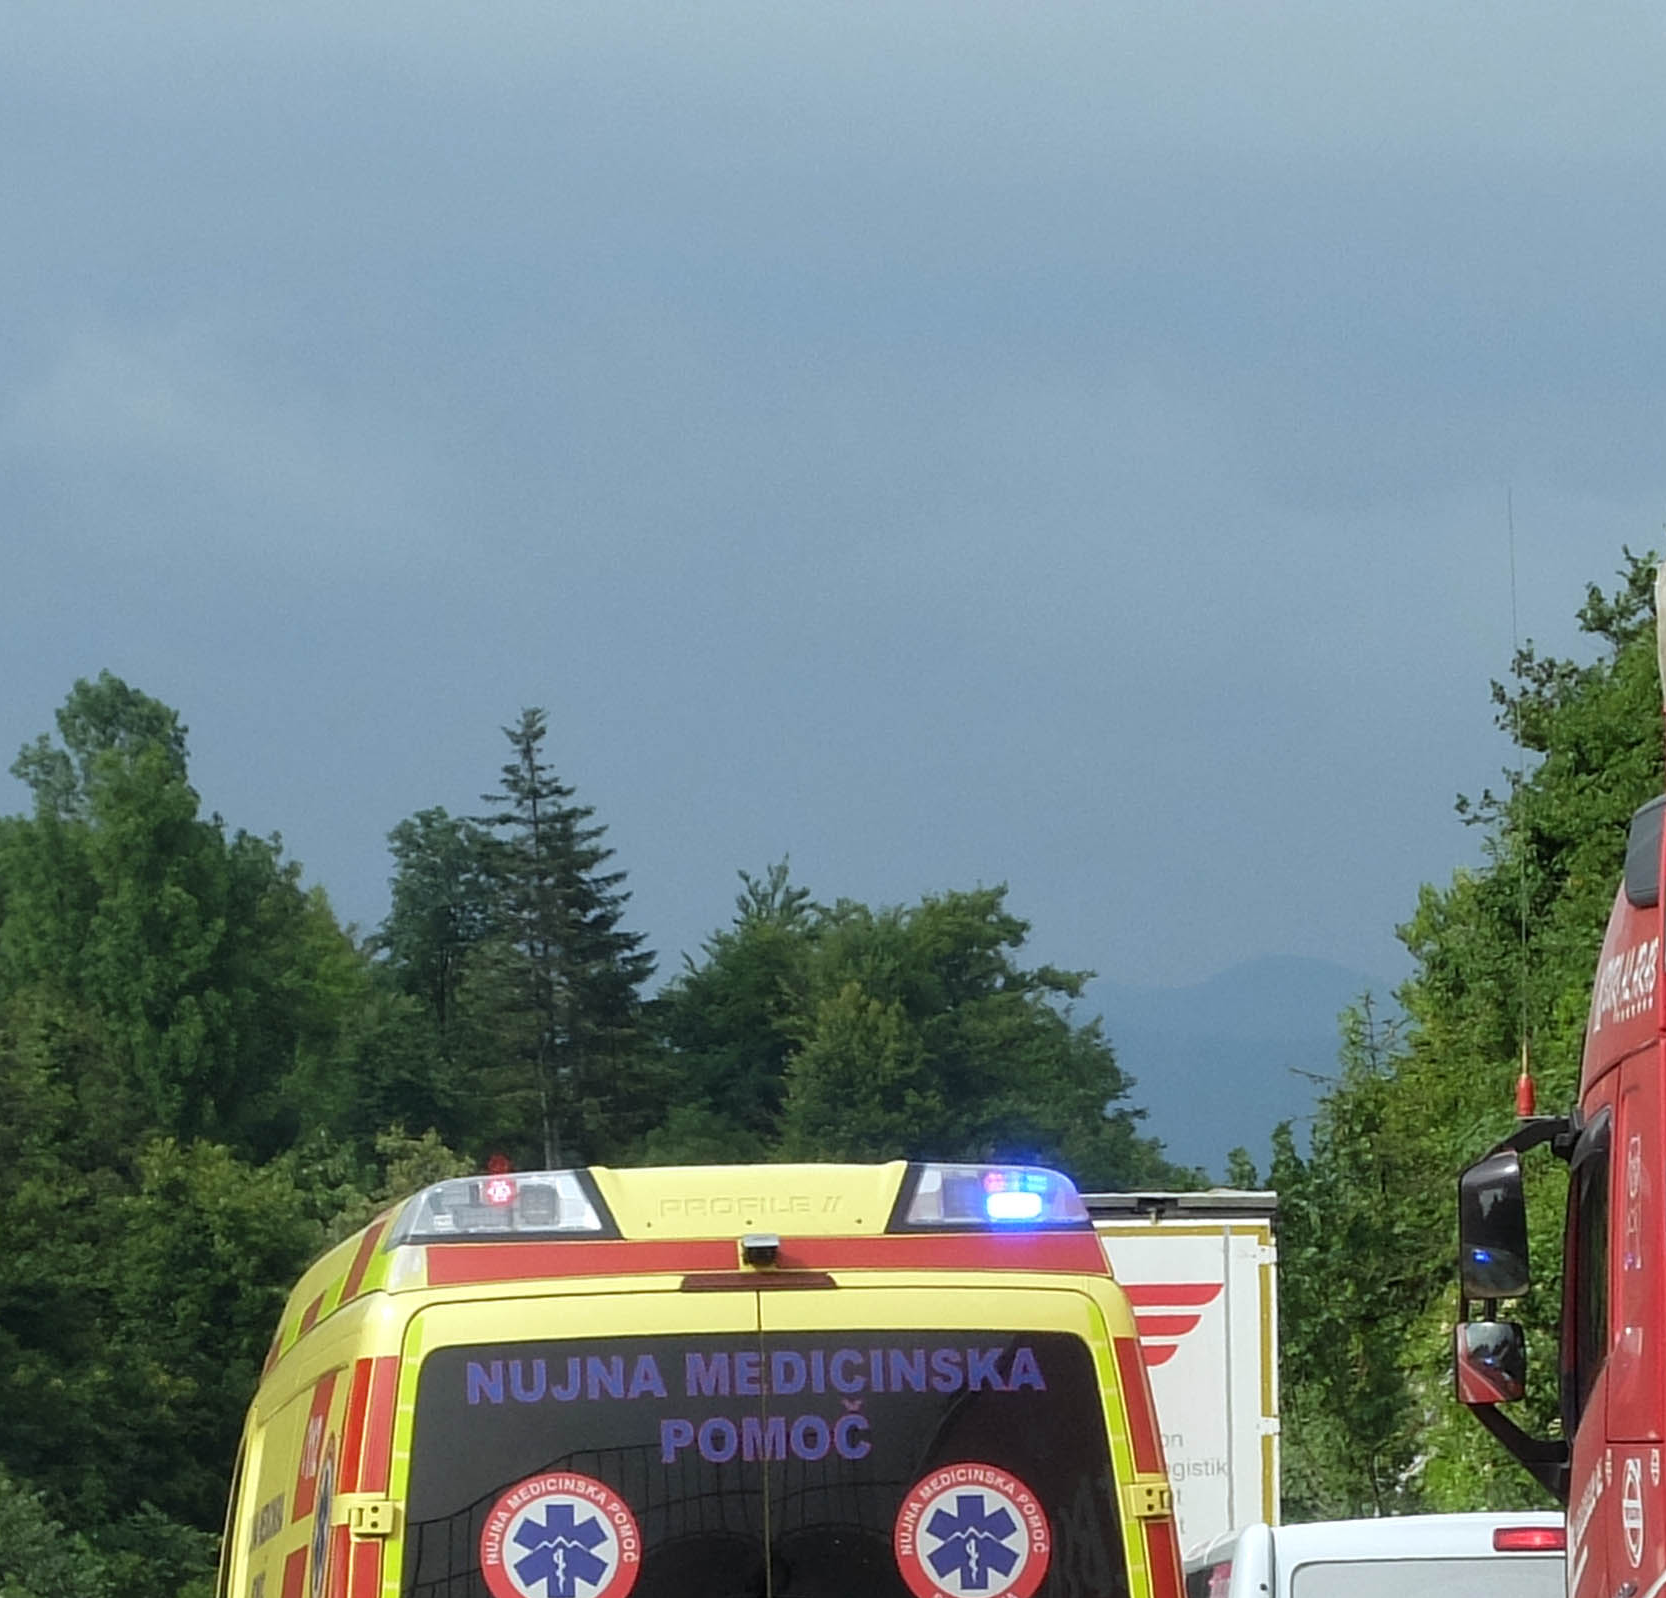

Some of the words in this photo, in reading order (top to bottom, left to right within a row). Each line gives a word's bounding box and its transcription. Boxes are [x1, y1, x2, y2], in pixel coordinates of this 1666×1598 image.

[660, 1196, 811, 1217] PROFILE
[466, 1354, 667, 1405] NUJNA
[685, 1347, 1047, 1397] MEDICINSKA
[660, 1399, 872, 1464] POMOČ
[1167, 1458, 1228, 1482] gistik
[484, 1511, 511, 1565] NUJNA
[506, 1478, 608, 1510] MEDICINSKA
[607, 1503, 640, 1563] POMOČ
[900, 1501, 923, 1556] NUJNA
[919, 1468, 1016, 1500] MEDICINSKA
[1015, 1493, 1050, 1554] POMOČ
